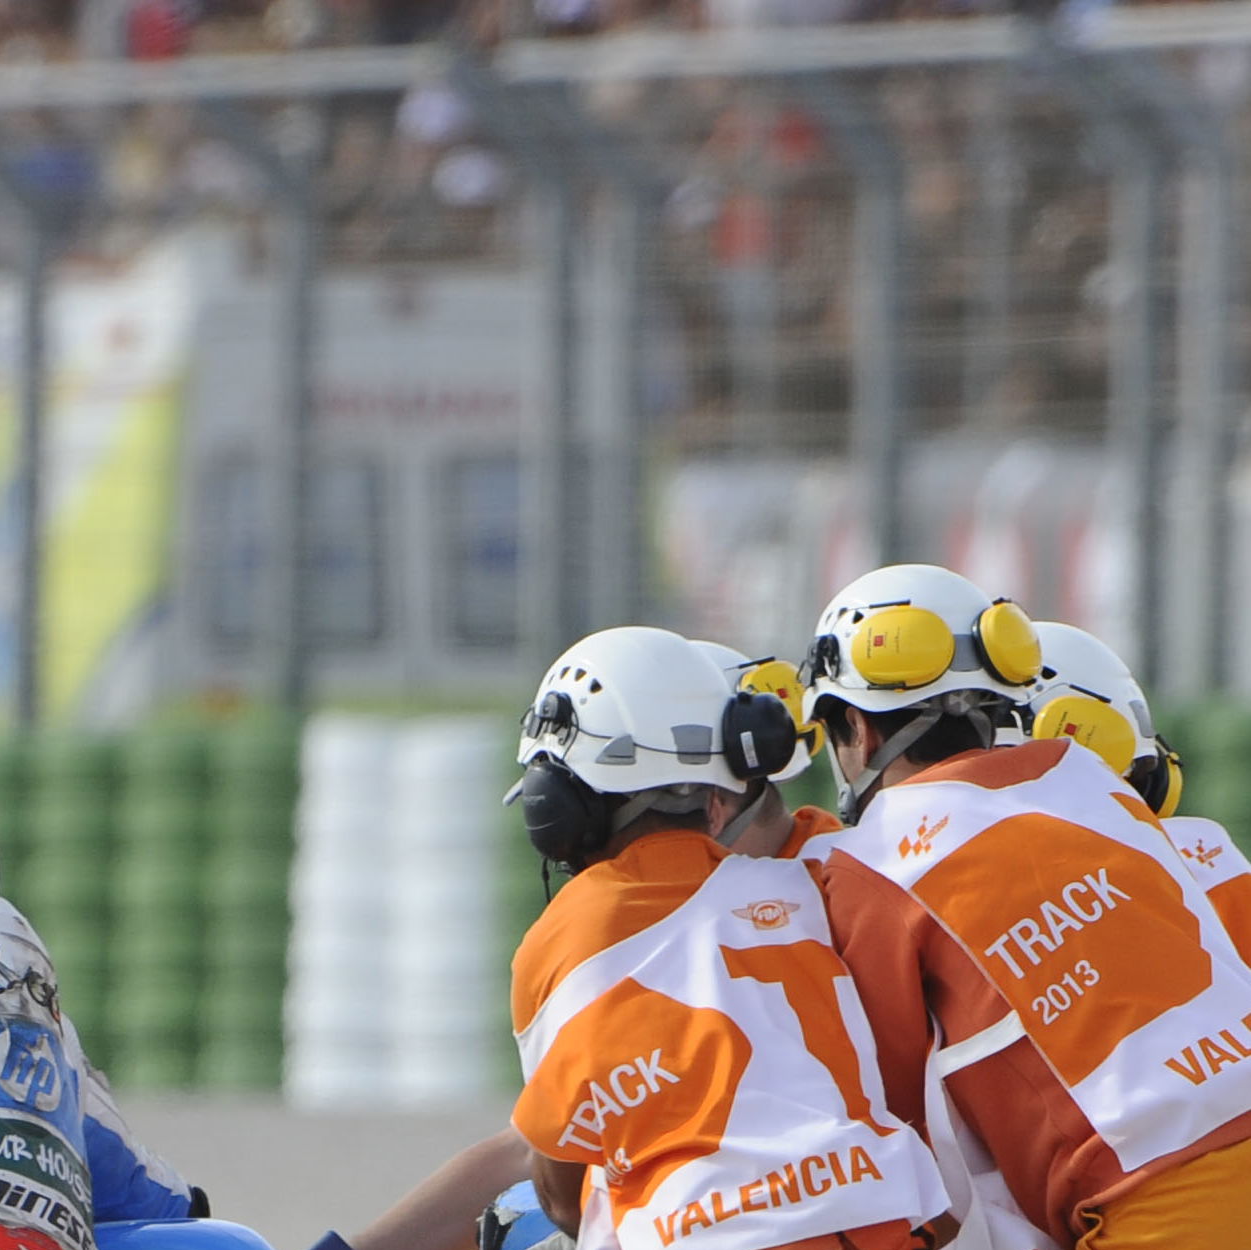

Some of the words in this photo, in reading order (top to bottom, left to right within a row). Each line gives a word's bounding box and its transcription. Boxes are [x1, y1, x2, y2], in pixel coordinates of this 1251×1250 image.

[984, 868, 1132, 980] TRACK
[1031, 959, 1101, 1025] 2013
[557, 1048, 681, 1151] TRACK
[1164, 1012, 1251, 1086] VAL
[653, 1145, 883, 1248] VALENCIA
